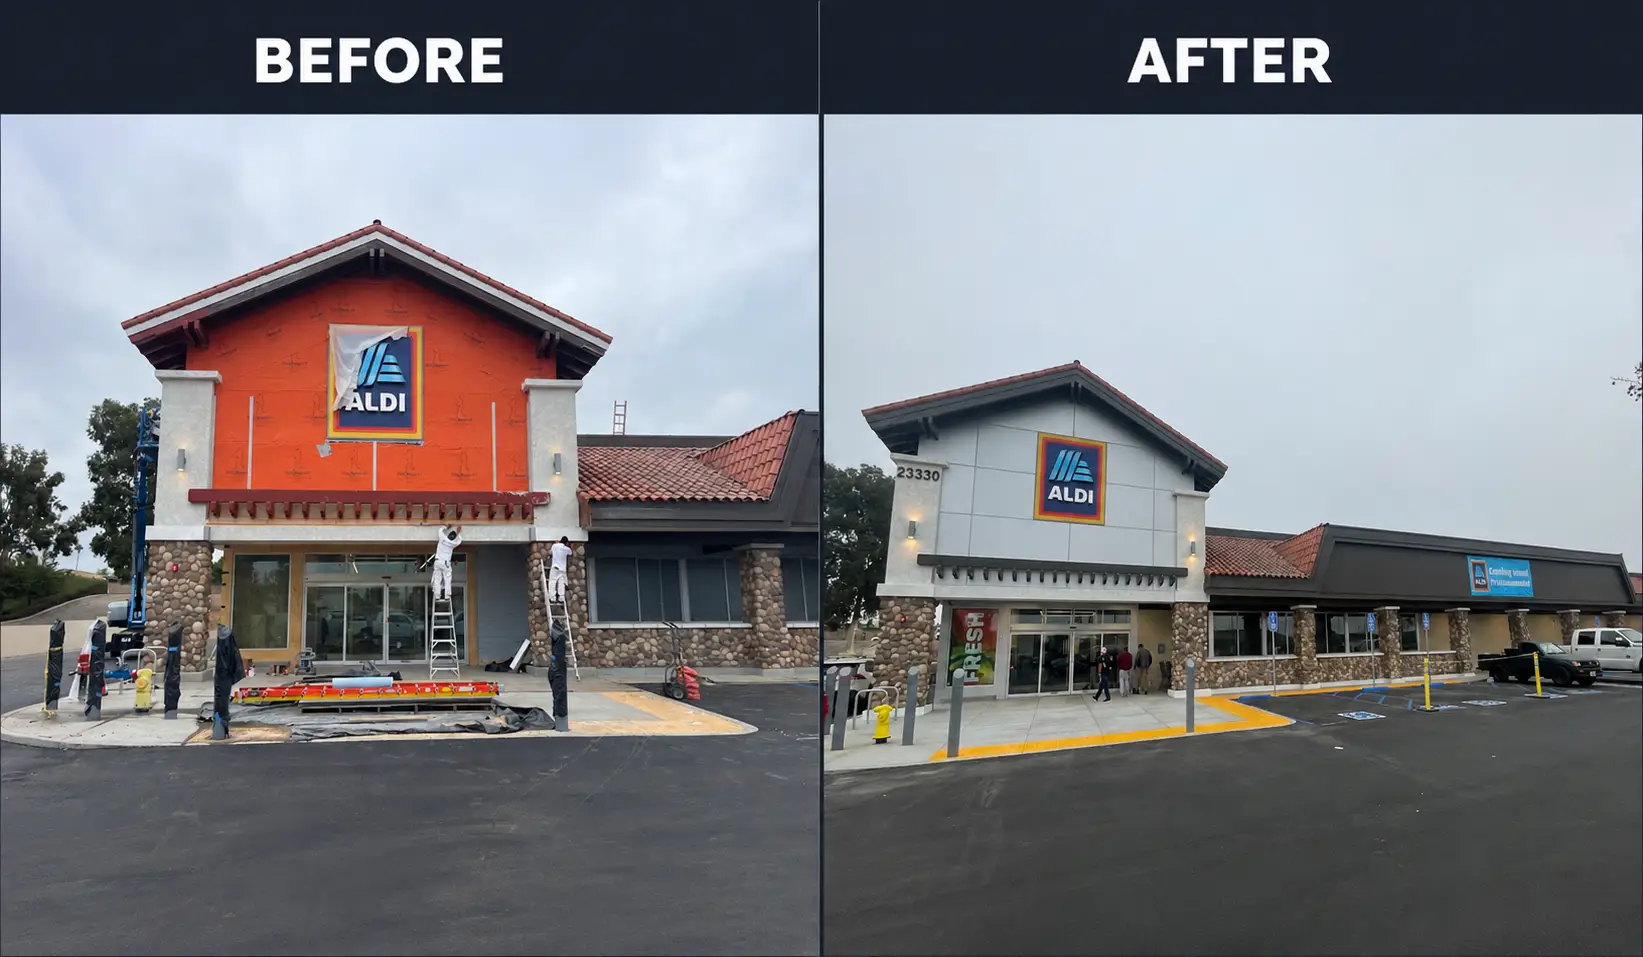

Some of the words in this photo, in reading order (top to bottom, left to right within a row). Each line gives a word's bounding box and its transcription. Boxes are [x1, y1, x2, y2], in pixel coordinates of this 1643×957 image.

[345, 391, 406, 412] ALDI
[897, 466, 940, 482] 23330
[1048, 485, 1094, 504] ALDI
[963, 612, 985, 682] FRESH
